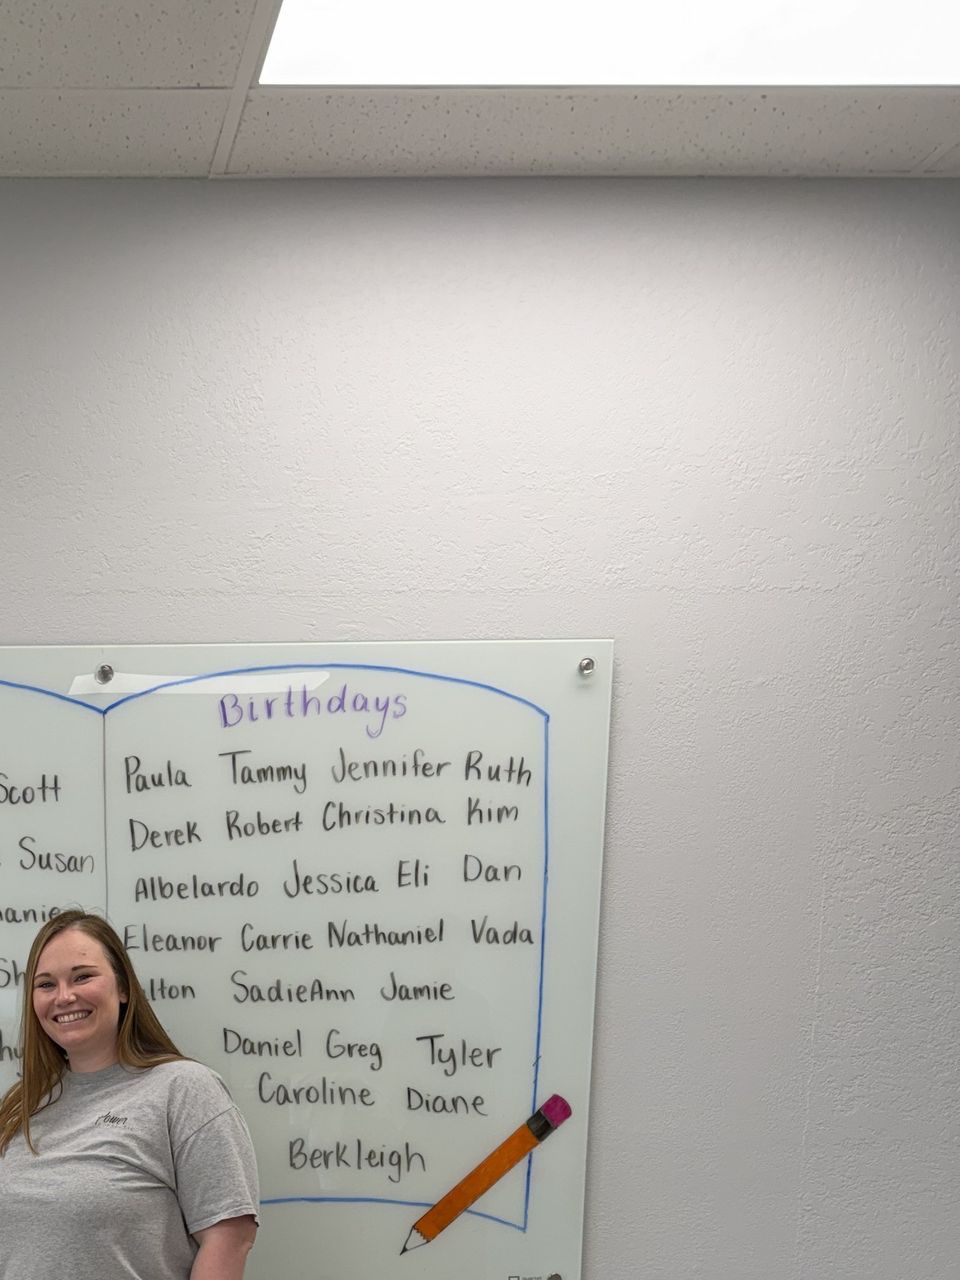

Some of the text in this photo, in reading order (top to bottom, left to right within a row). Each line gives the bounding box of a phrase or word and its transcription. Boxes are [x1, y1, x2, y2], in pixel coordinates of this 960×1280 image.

[219, 684, 408, 740] Birthdays
[124, 748, 532, 794] Paula Tammy Jennifer Ruth
[129, 797, 518, 852] Derek Robert Christina Kim
[19, 836, 94, 873] Susan
[135, 854, 521, 902] Albelardo Jessica Eli Dan
[124, 916, 534, 952] Eleanor Carrie Nathaniel Vada
[149, 971, 455, 1003] lton SadieAnn Jamie
[223, 1028, 501, 1077] Daniel Greg Tyler
[258, 1072, 486, 1116] Caroline Diane
[289, 1138, 425, 1182] Berkleigh
